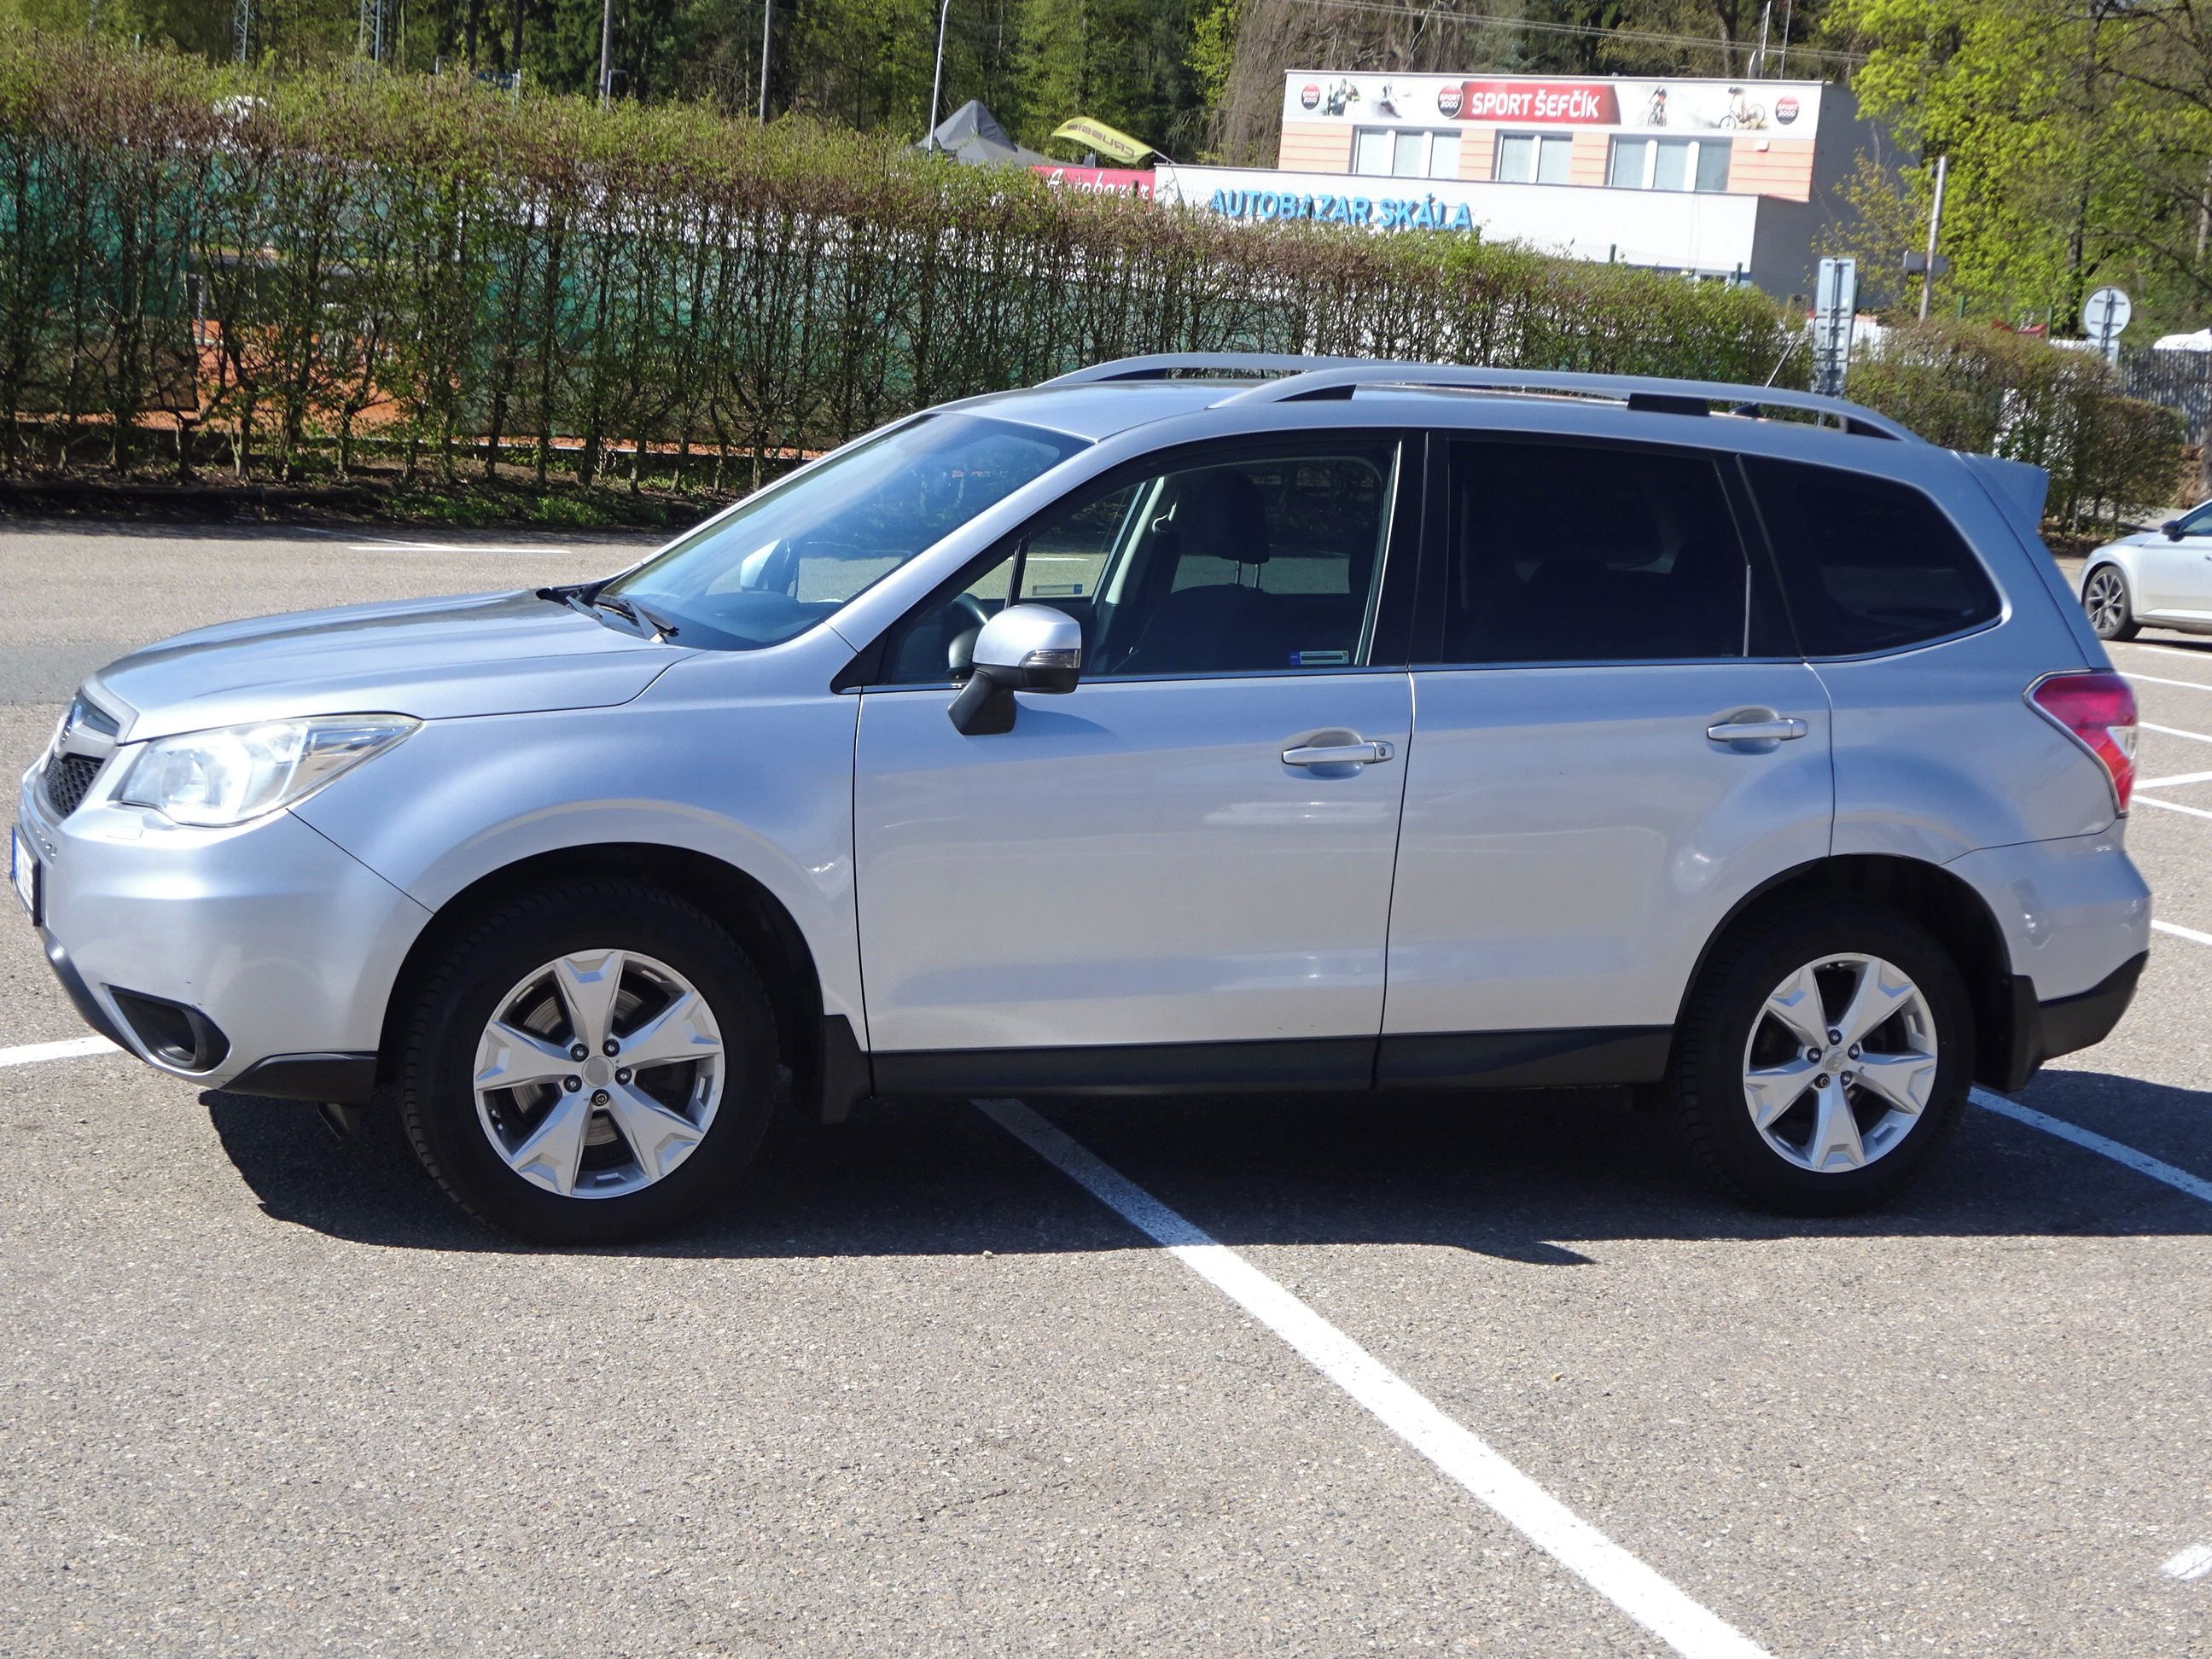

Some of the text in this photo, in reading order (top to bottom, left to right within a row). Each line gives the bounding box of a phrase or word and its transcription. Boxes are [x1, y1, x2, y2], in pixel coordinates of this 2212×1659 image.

[1439, 93, 1462, 102] SPORT
[1471, 89, 1601, 119] SPORT ŠEFČÍK
[1047, 168, 1150, 200] Atobazr
[1211, 189, 1474, 230] AUTOBAZAR SKÁLA
